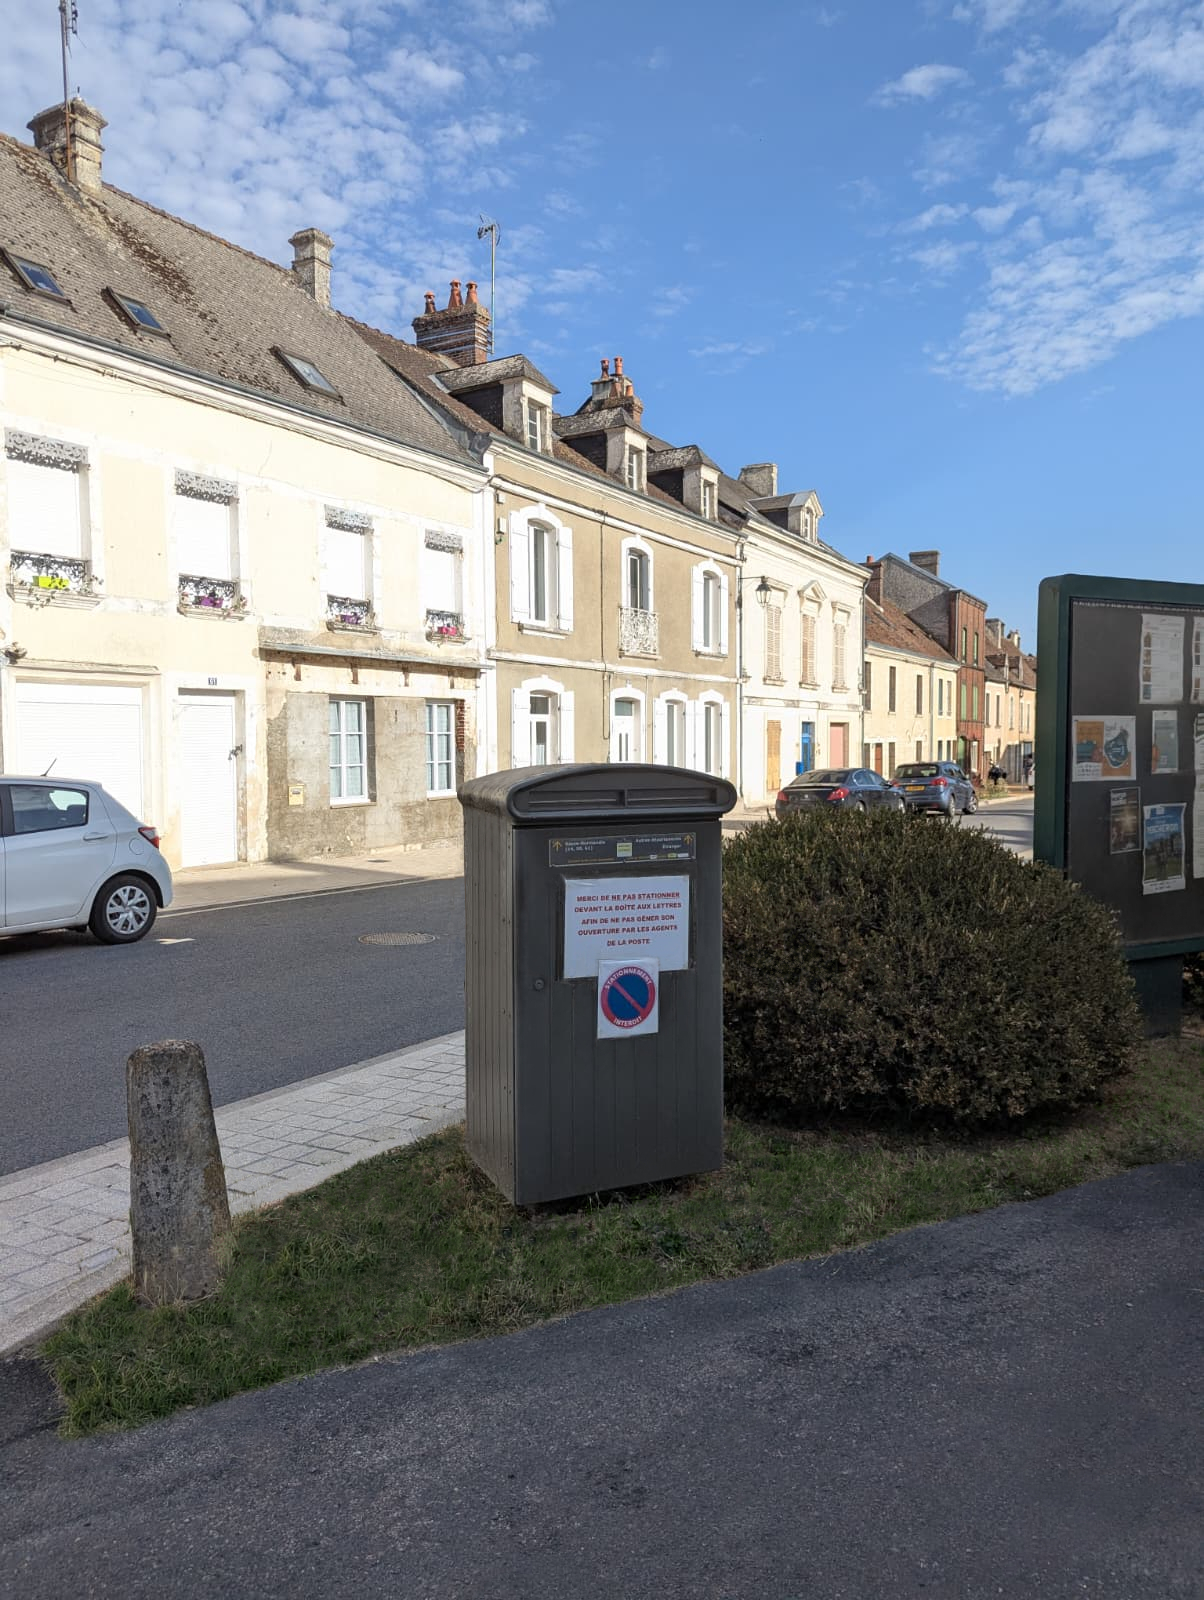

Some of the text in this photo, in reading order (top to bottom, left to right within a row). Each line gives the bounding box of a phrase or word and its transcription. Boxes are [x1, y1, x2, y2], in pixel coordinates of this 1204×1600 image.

[577, 928, 620, 936] OUVERTURE
[651, 924, 678, 932] AGENTS
[604, 967, 653, 990] STATIONNEMENT
[613, 1015, 642, 1027] INTERDIT
